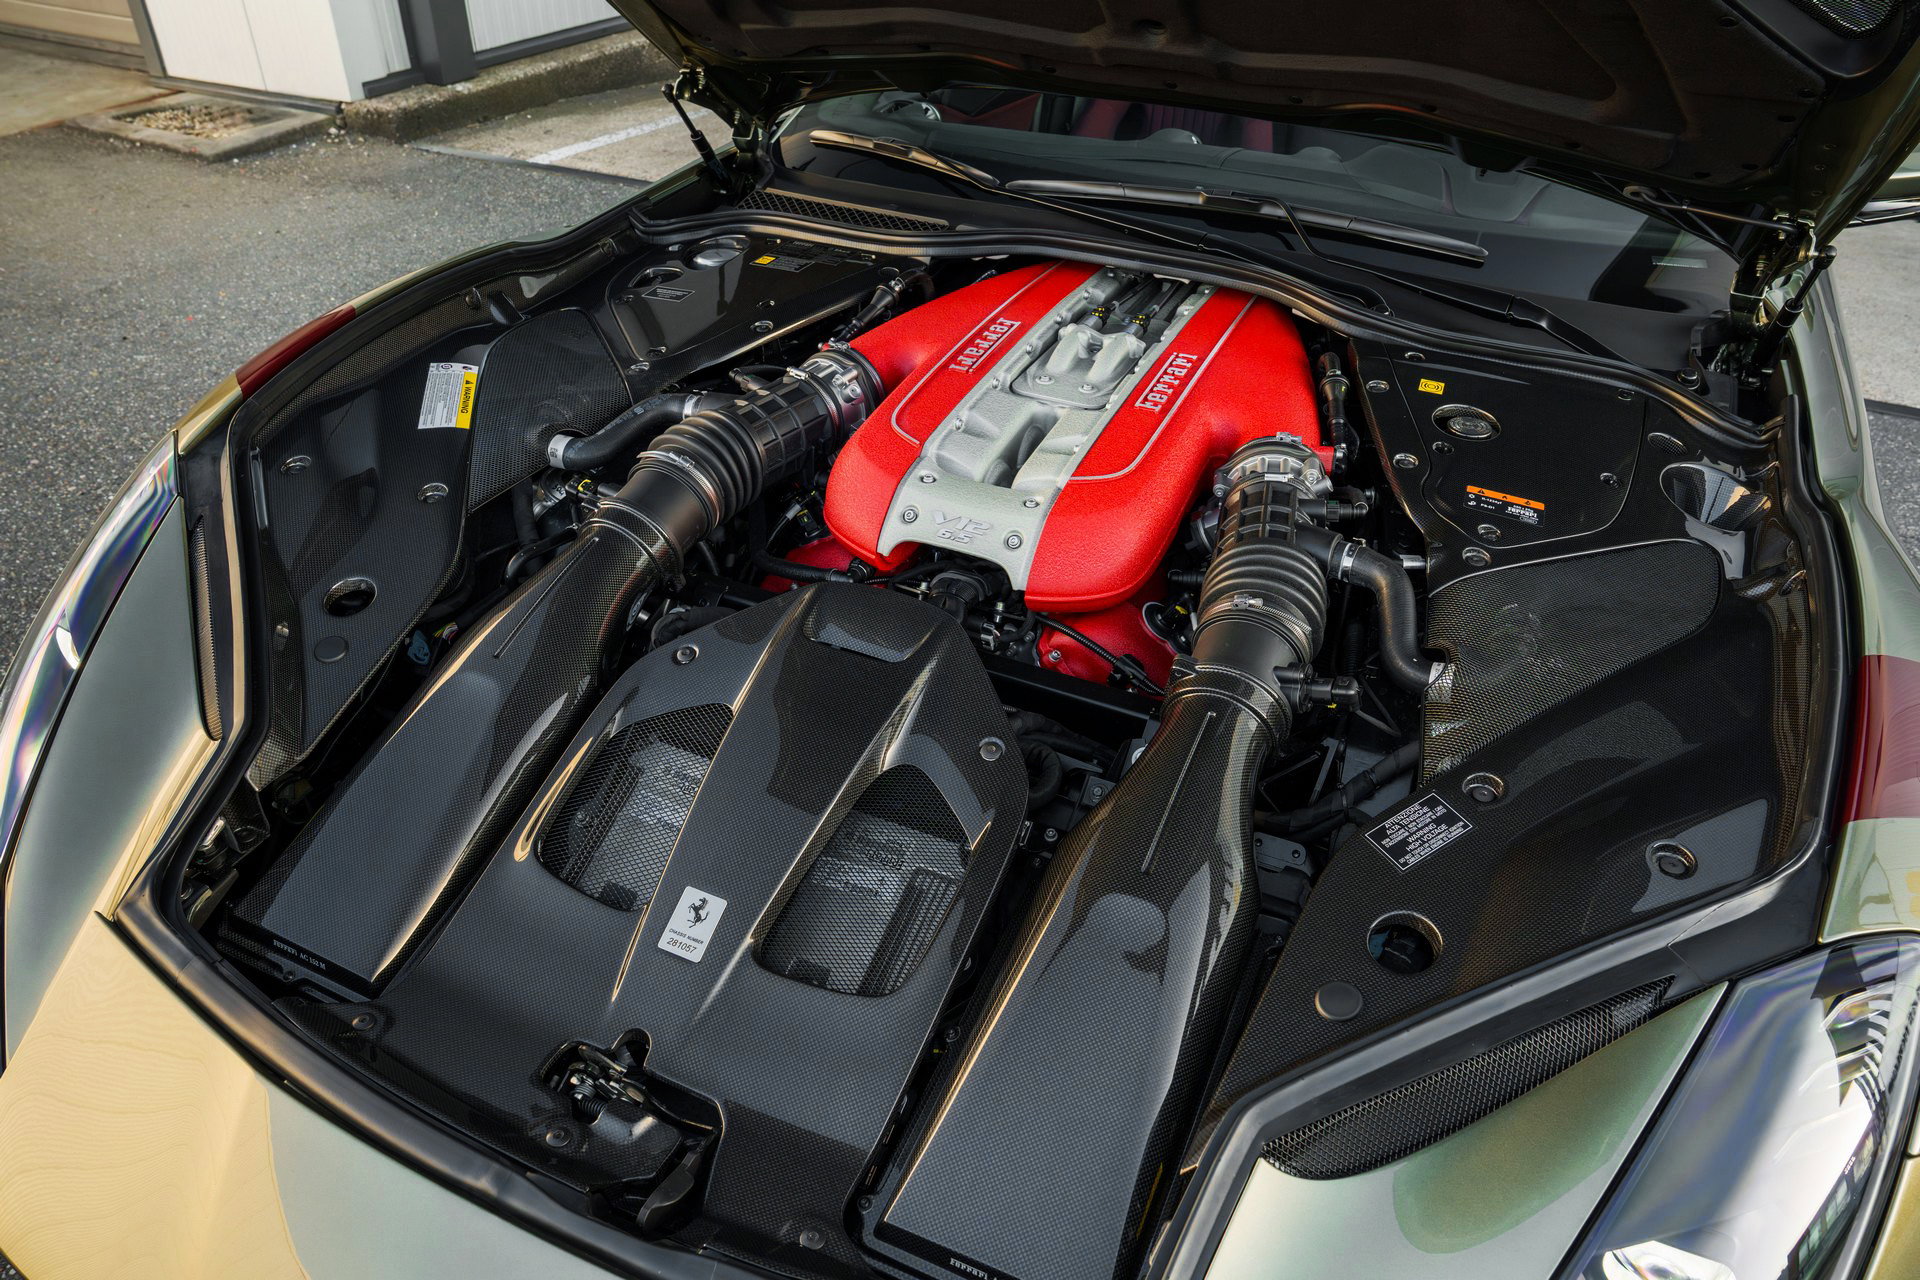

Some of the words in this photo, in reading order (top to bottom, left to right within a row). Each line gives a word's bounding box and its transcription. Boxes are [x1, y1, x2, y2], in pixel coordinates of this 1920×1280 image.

[948, 317, 1021, 374] Ferrari
[1134, 352, 1198, 412] Ferrari
[461, 386, 472, 414] WARNING
[932, 510, 992, 536] V12
[937, 528, 973, 545] 6.5
[1383, 803, 1422, 828] ATTENZIONE
[1384, 823, 1401, 835] ALTA
[1399, 805, 1430, 826] TENSIONE
[1405, 822, 1437, 843] WARNING
[1405, 839, 1423, 851] HIGH
[1420, 823, 1448, 842] VOLTAGE
[667, 937, 697, 954] 281057
[669, 928, 687, 938] CHASSIS
[687, 935, 704, 945] NUMBER
[950, 1257, 988, 1280] Ferrari
